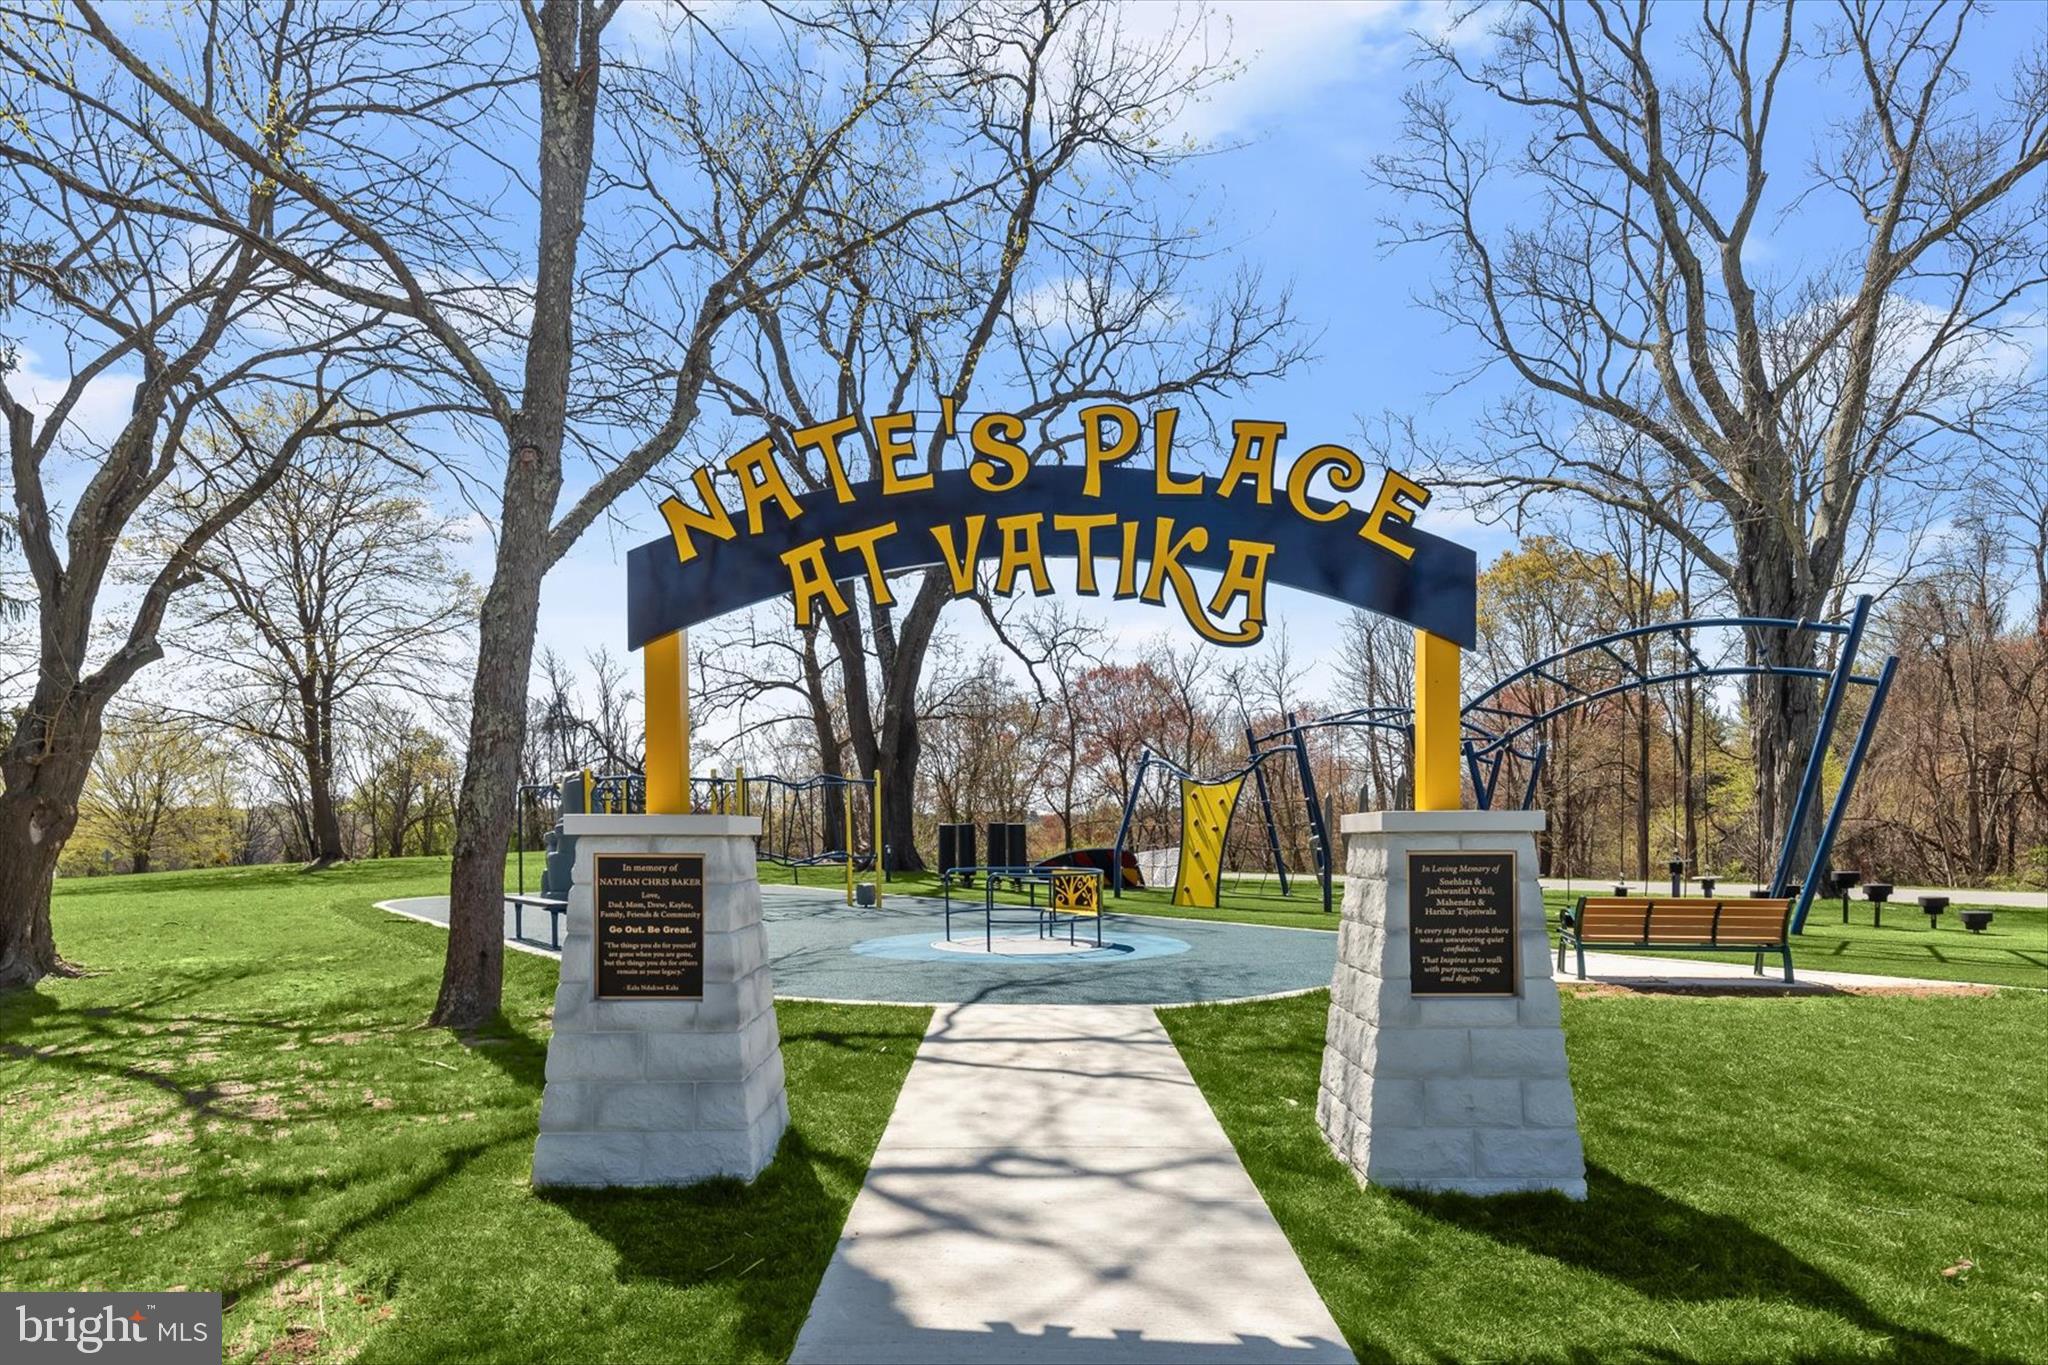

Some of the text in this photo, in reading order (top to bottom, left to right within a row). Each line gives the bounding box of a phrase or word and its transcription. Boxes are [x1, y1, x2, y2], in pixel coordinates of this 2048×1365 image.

[658, 396, 1432, 564] NATE'S PLACE
[779, 512, 1276, 648] AT VATIKA
[1432, 865, 1457, 874] Loving
[1459, 865, 1491, 874] Memory
[1492, 865, 1500, 874] of
[1472, 887, 1495, 895] Vakil,
[661, 911, 700, 919] Community
[1459, 927, 1473, 935] they
